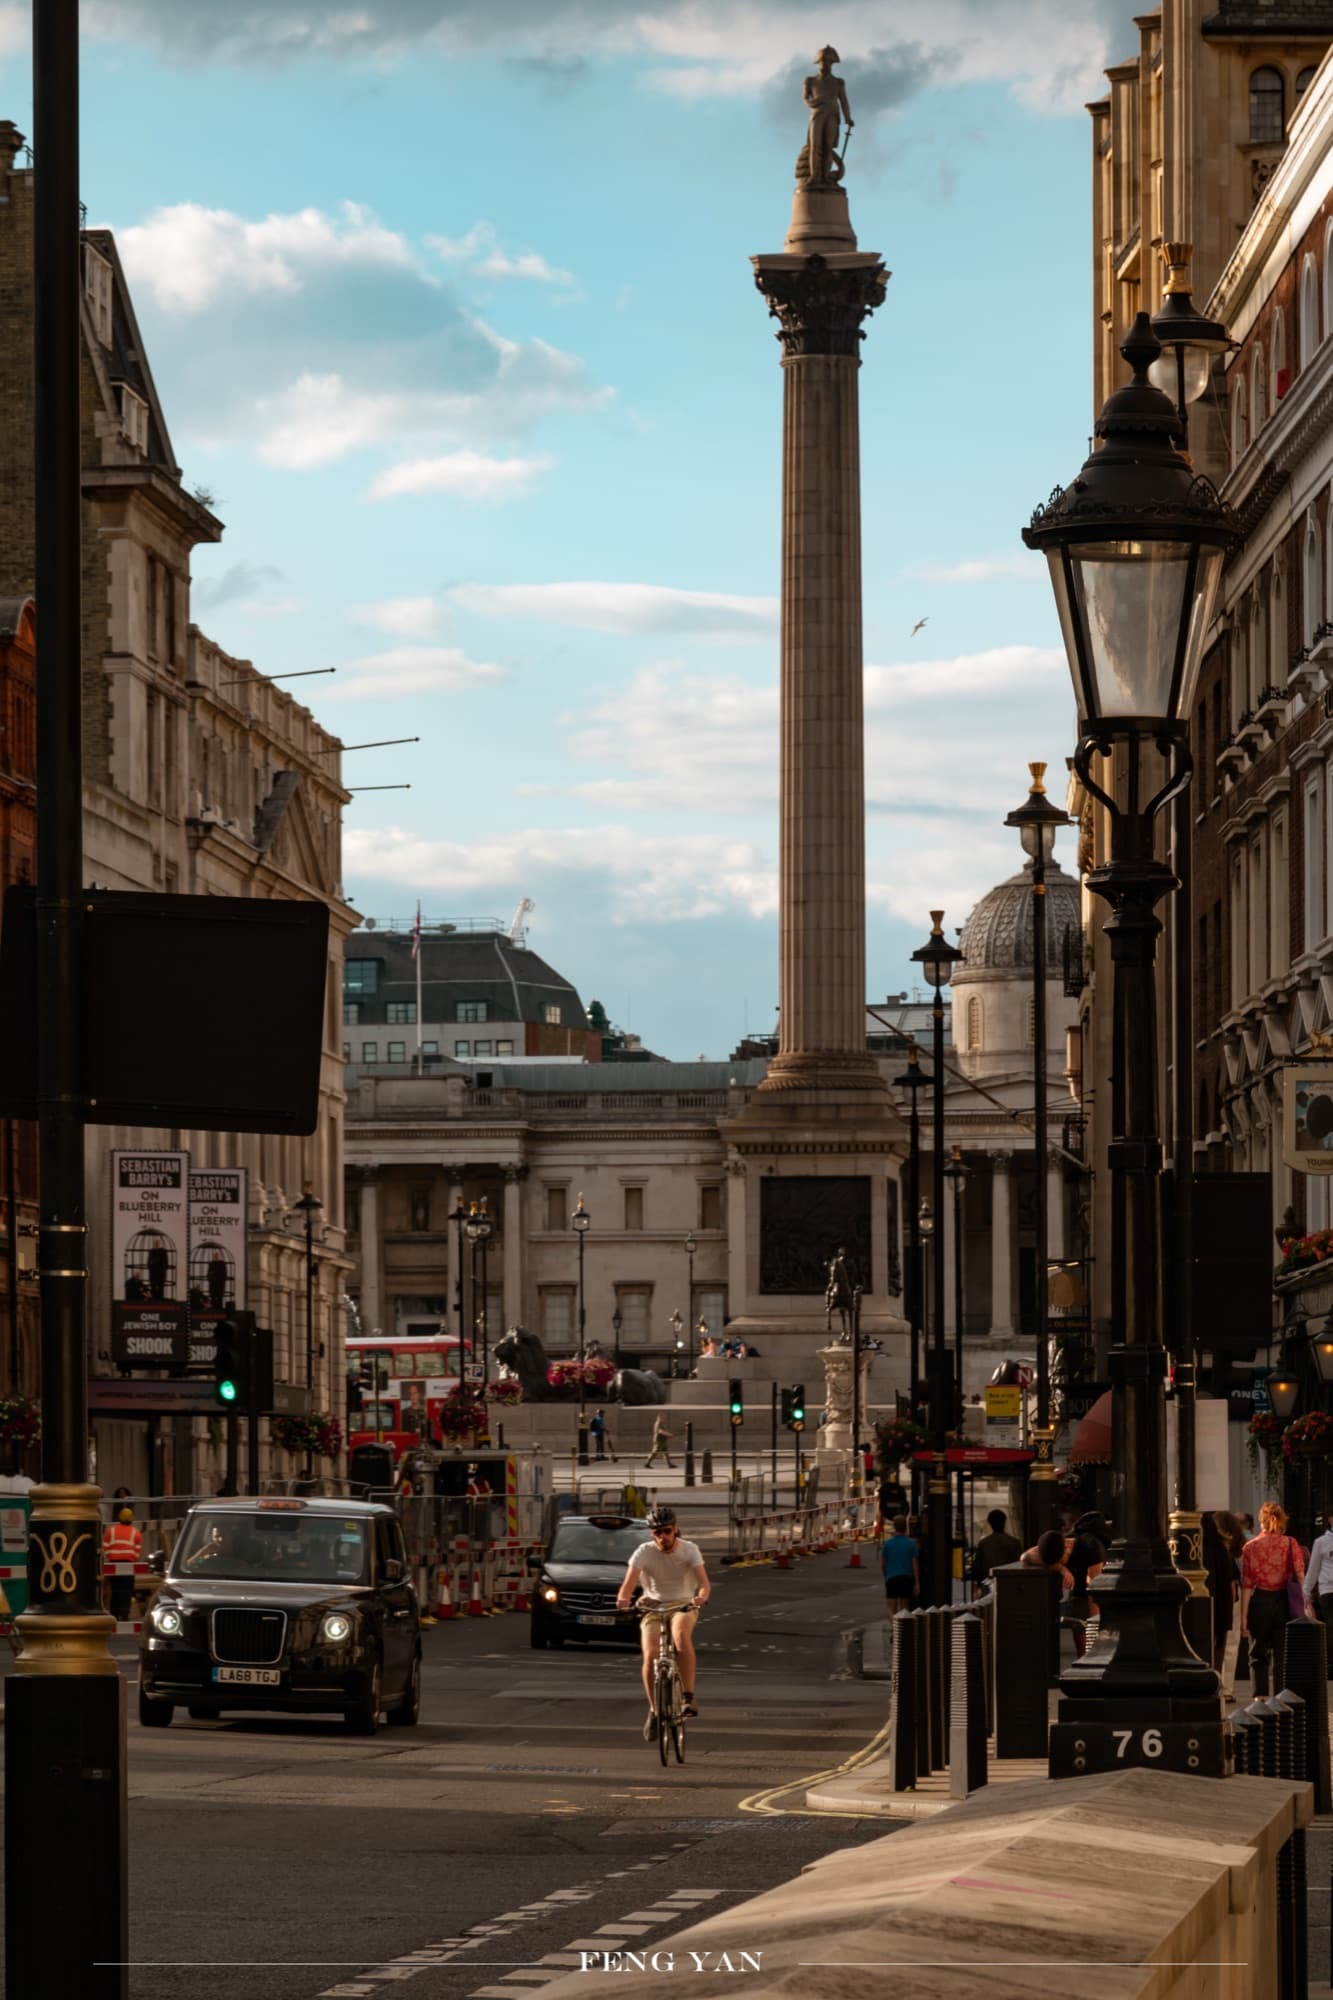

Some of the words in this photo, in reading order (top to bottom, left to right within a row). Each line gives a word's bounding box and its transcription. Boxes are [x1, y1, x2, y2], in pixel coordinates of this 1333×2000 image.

[120, 1159, 180, 1173] SEBASTIAN
[128, 1173, 174, 1186] BARRY's
[188, 1175, 238, 1189] EBASTIAN
[141, 1190, 160, 1201] ON
[119, 1201, 182, 1212] BLUEBERRY
[201, 1205, 218, 1215] ON
[138, 1212, 163, 1223] HILL
[190, 1216, 239, 1226] UEBERRY
[198, 1226, 222, 1236] HILL
[139, 1312, 161, 1322] ONE
[121, 1321, 157, 1330] JEWISH
[158, 1321, 178, 1330] BOY
[126, 1336, 174, 1355] SHOOK
[1018, 1368, 1032, 1384] N
[1231, 1389, 1267, 1400] ONEY
[219, 1669, 252, 1682] LA68
[255, 1671, 278, 1683] TGJ
[1112, 1728, 1164, 1758] 76
